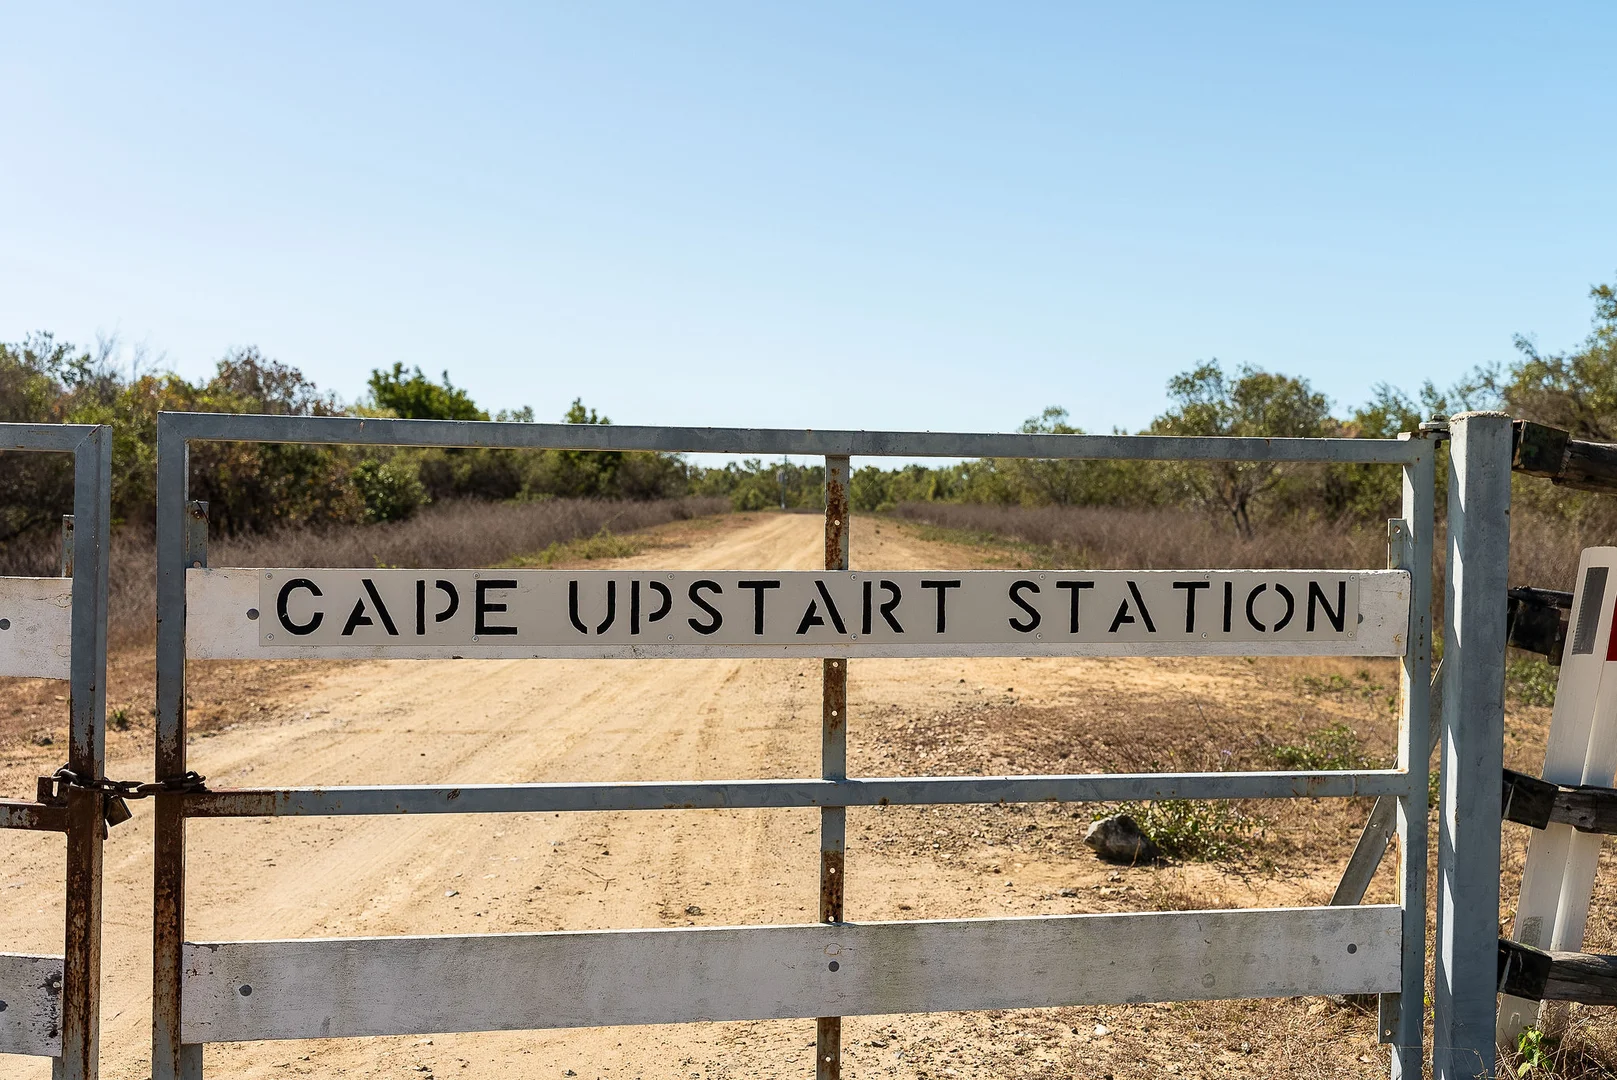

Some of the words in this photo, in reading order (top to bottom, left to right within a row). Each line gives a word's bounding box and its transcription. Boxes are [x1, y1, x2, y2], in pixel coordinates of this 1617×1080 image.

[276, 578, 518, 636] CAPE
[568, 579, 962, 636] UPSTART
[1008, 580, 1347, 634] STATION
